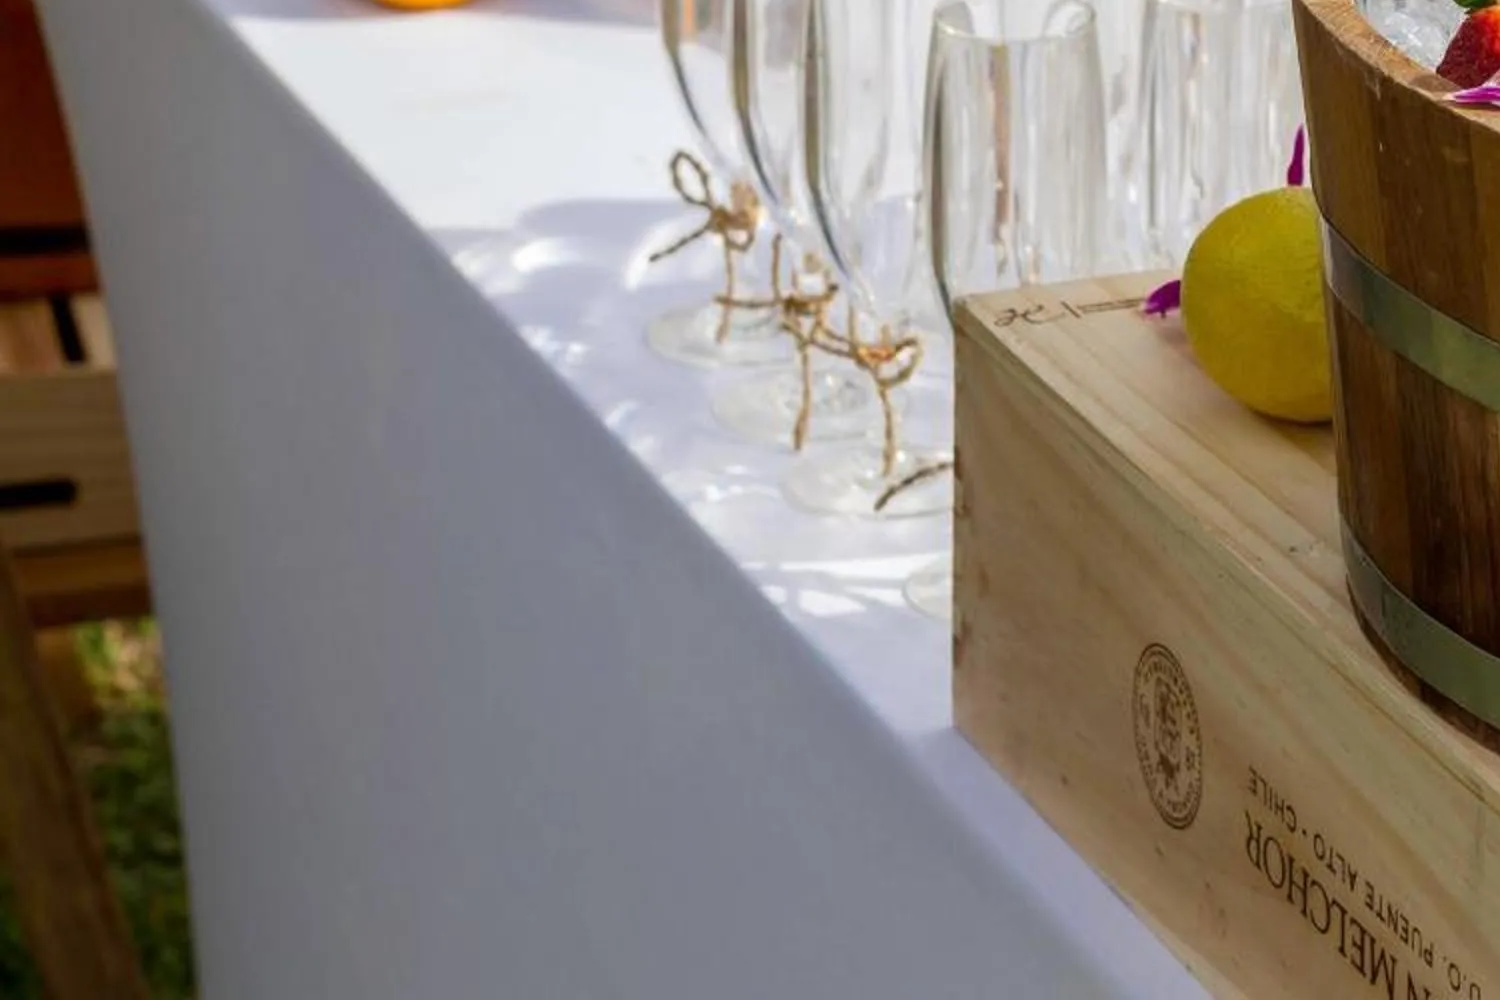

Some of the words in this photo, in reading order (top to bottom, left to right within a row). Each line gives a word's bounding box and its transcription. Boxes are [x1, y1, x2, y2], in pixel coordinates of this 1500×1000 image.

[1248, 764, 1297, 834] CHILE
[1313, 833, 1358, 893] ALTO
[1244, 809, 1397, 1000] MELCHOR
[1364, 880, 1435, 968] PUENTE
